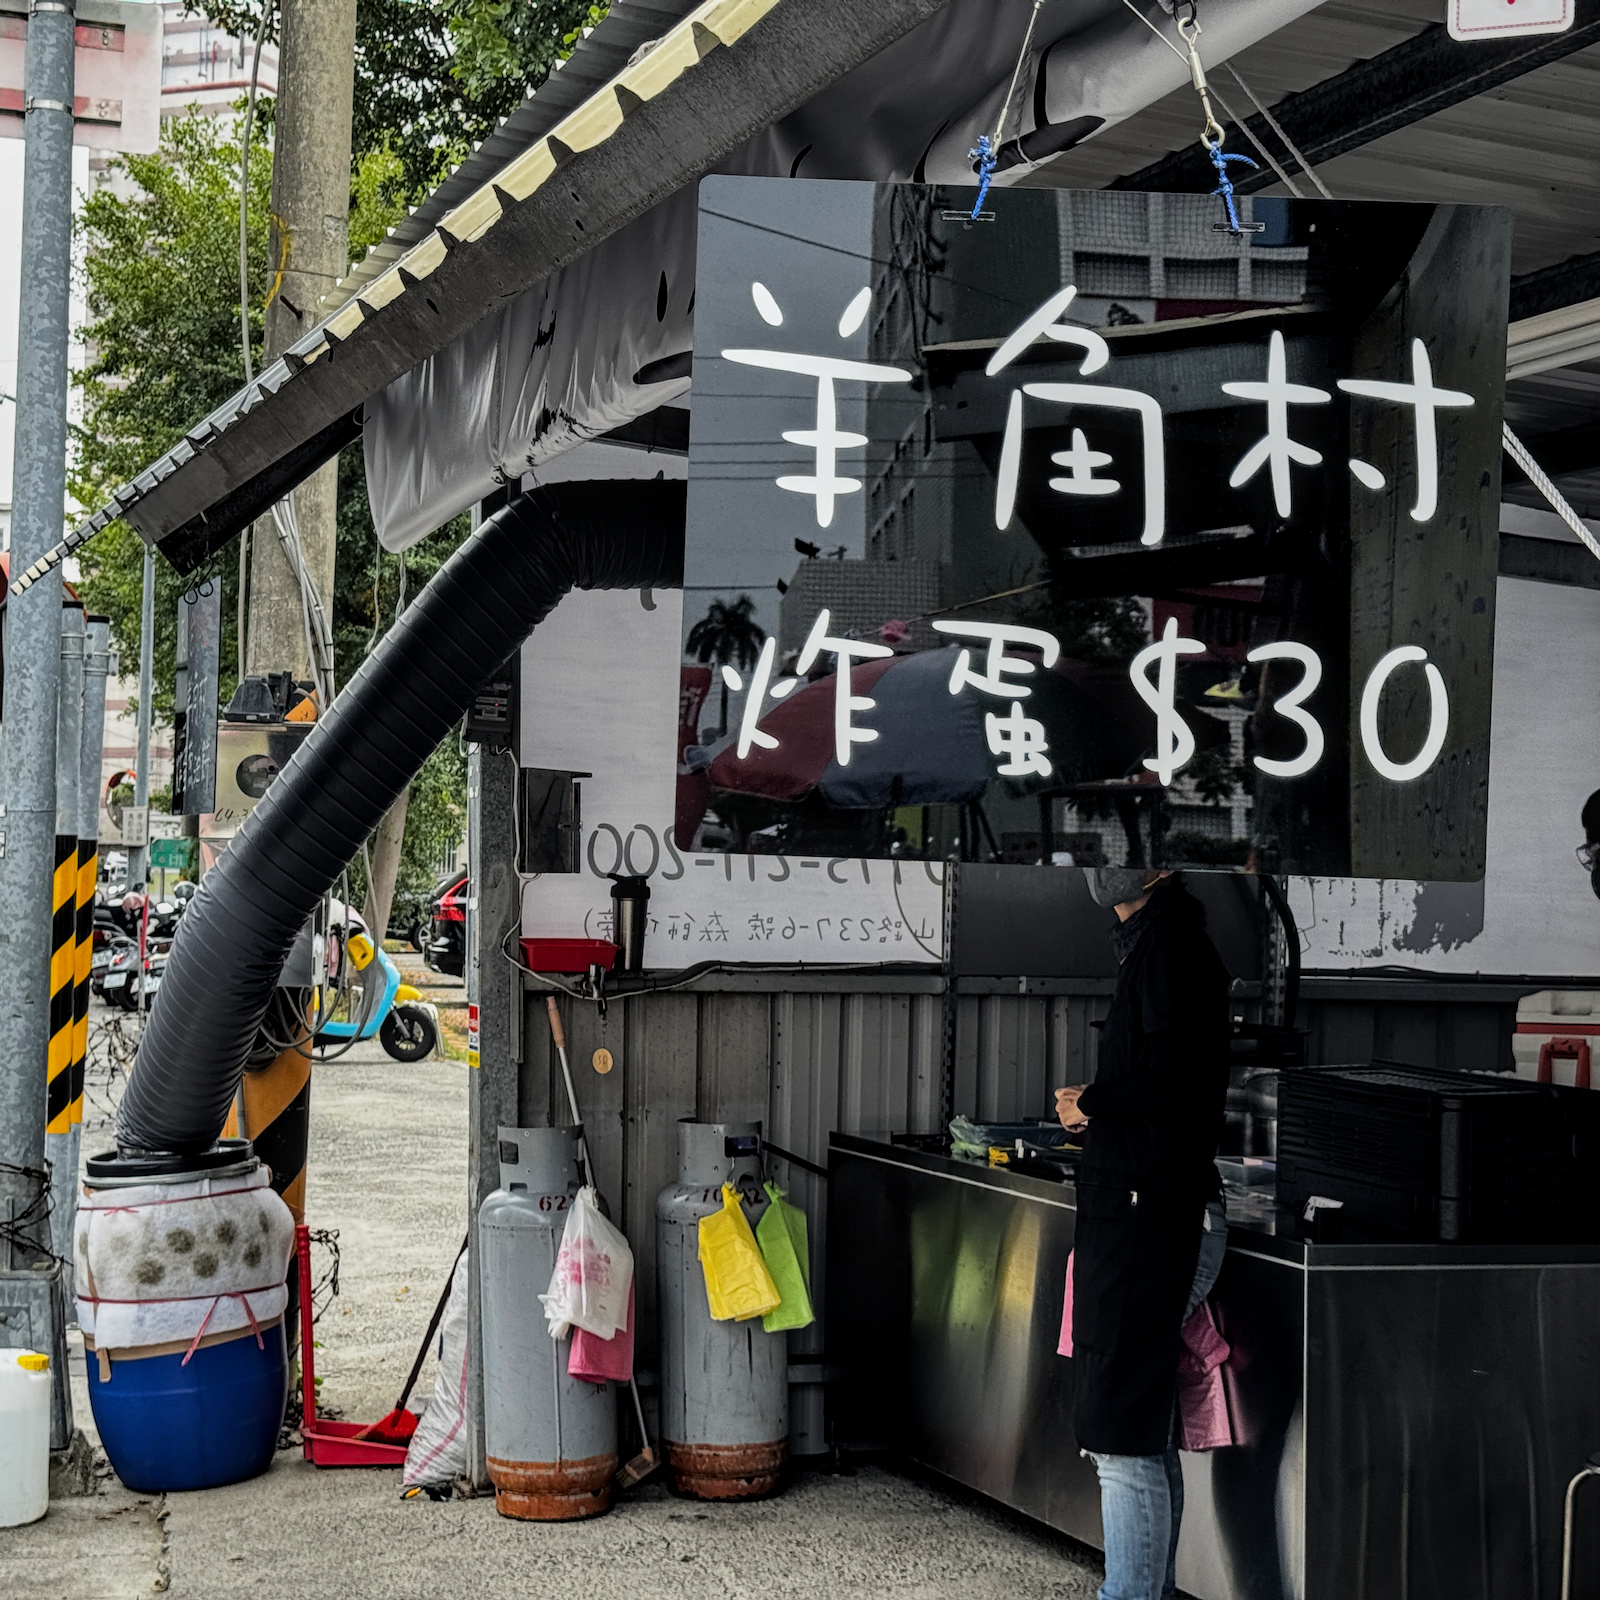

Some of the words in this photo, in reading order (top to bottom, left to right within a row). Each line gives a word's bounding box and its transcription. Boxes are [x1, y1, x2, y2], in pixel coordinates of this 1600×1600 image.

[720, 281, 1476, 547] 羊角村
[722, 608, 1062, 778] 炸蛋
[1129, 616, 1450, 786] $30
